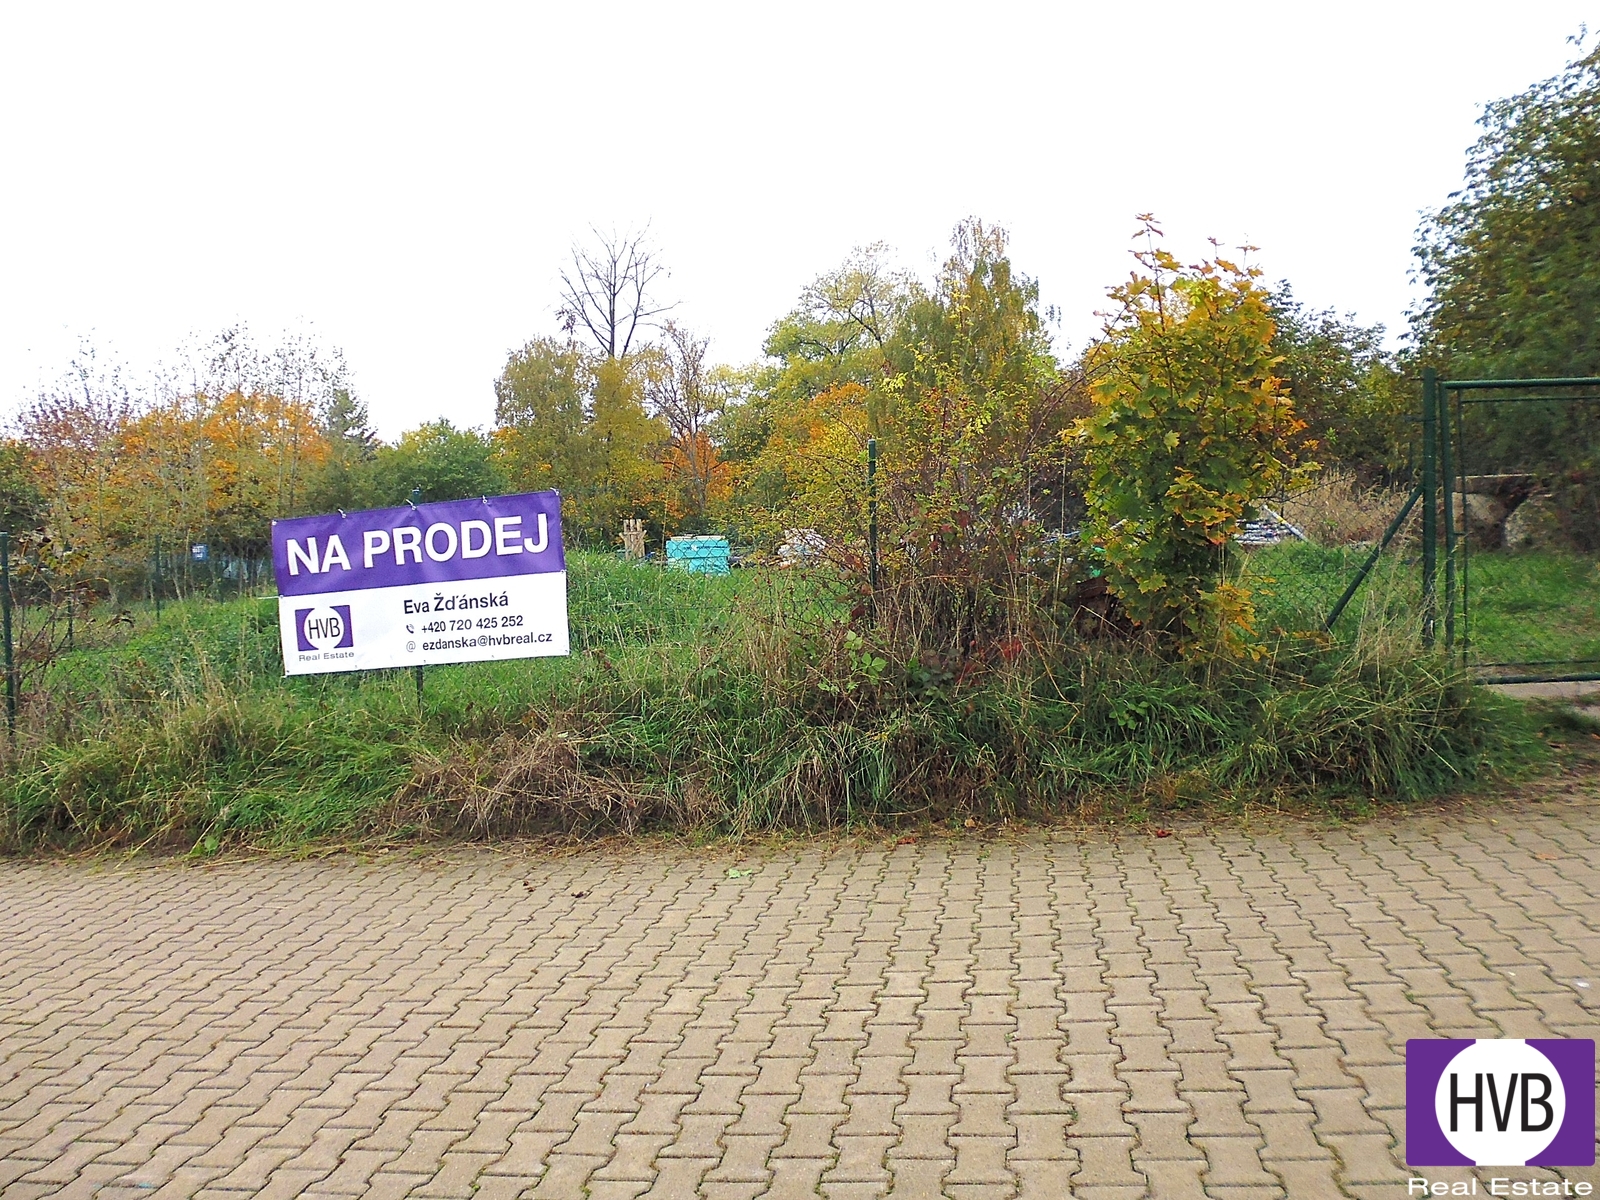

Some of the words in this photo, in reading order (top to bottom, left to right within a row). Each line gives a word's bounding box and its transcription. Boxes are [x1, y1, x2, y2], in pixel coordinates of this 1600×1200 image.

[286, 534, 351, 576] NA
[363, 513, 549, 569] PRODEJ
[403, 599, 430, 615] Eva
[433, 591, 509, 612] Žďánská
[308, 617, 341, 640] HVB
[421, 620, 446, 633] +420
[449, 619, 472, 631] 720
[476, 617, 498, 629] 425
[501, 615, 524, 628] 252
[422, 632, 553, 651] ezdanska@hvbreal.cz
[298, 654, 320, 662] Real
[323, 652, 355, 660] Estate
